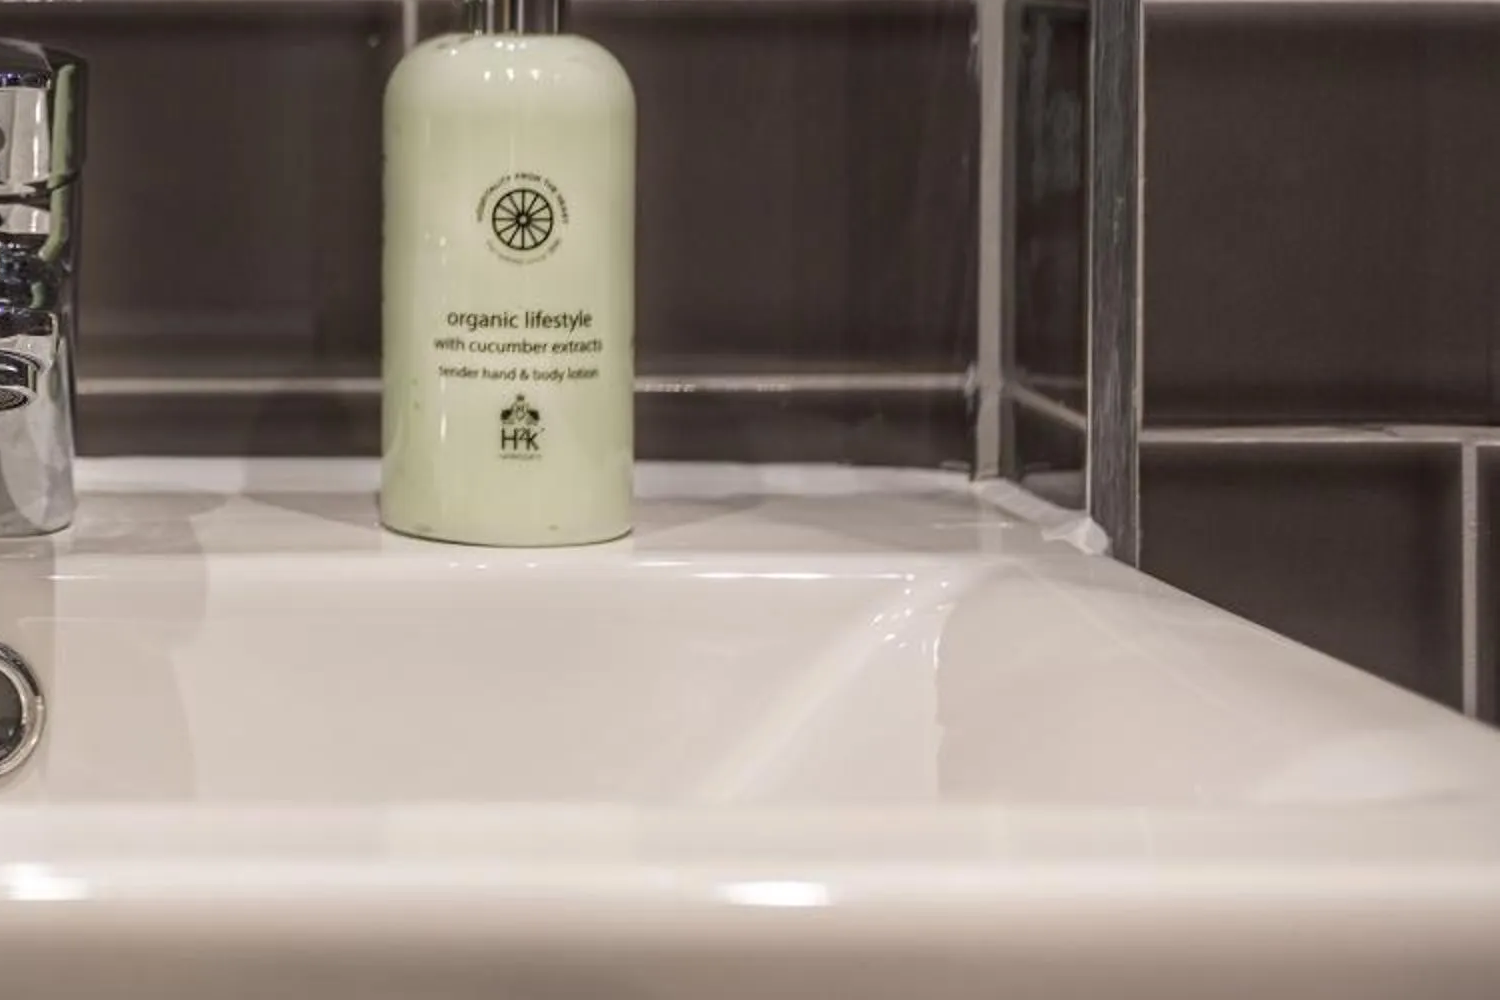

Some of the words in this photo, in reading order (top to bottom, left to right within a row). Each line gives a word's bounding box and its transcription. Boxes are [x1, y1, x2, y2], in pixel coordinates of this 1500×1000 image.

[447, 311, 519, 332] organic
[525, 310, 592, 332] lifestyle
[434, 338, 465, 352] with
[468, 338, 547, 354] cucumber
[551, 339, 603, 355] extracts
[438, 365, 479, 379] tender
[482, 366, 516, 381] hand
[519, 368, 529, 381] &
[532, 367, 566, 384] body
[567, 366, 600, 380] lotion
